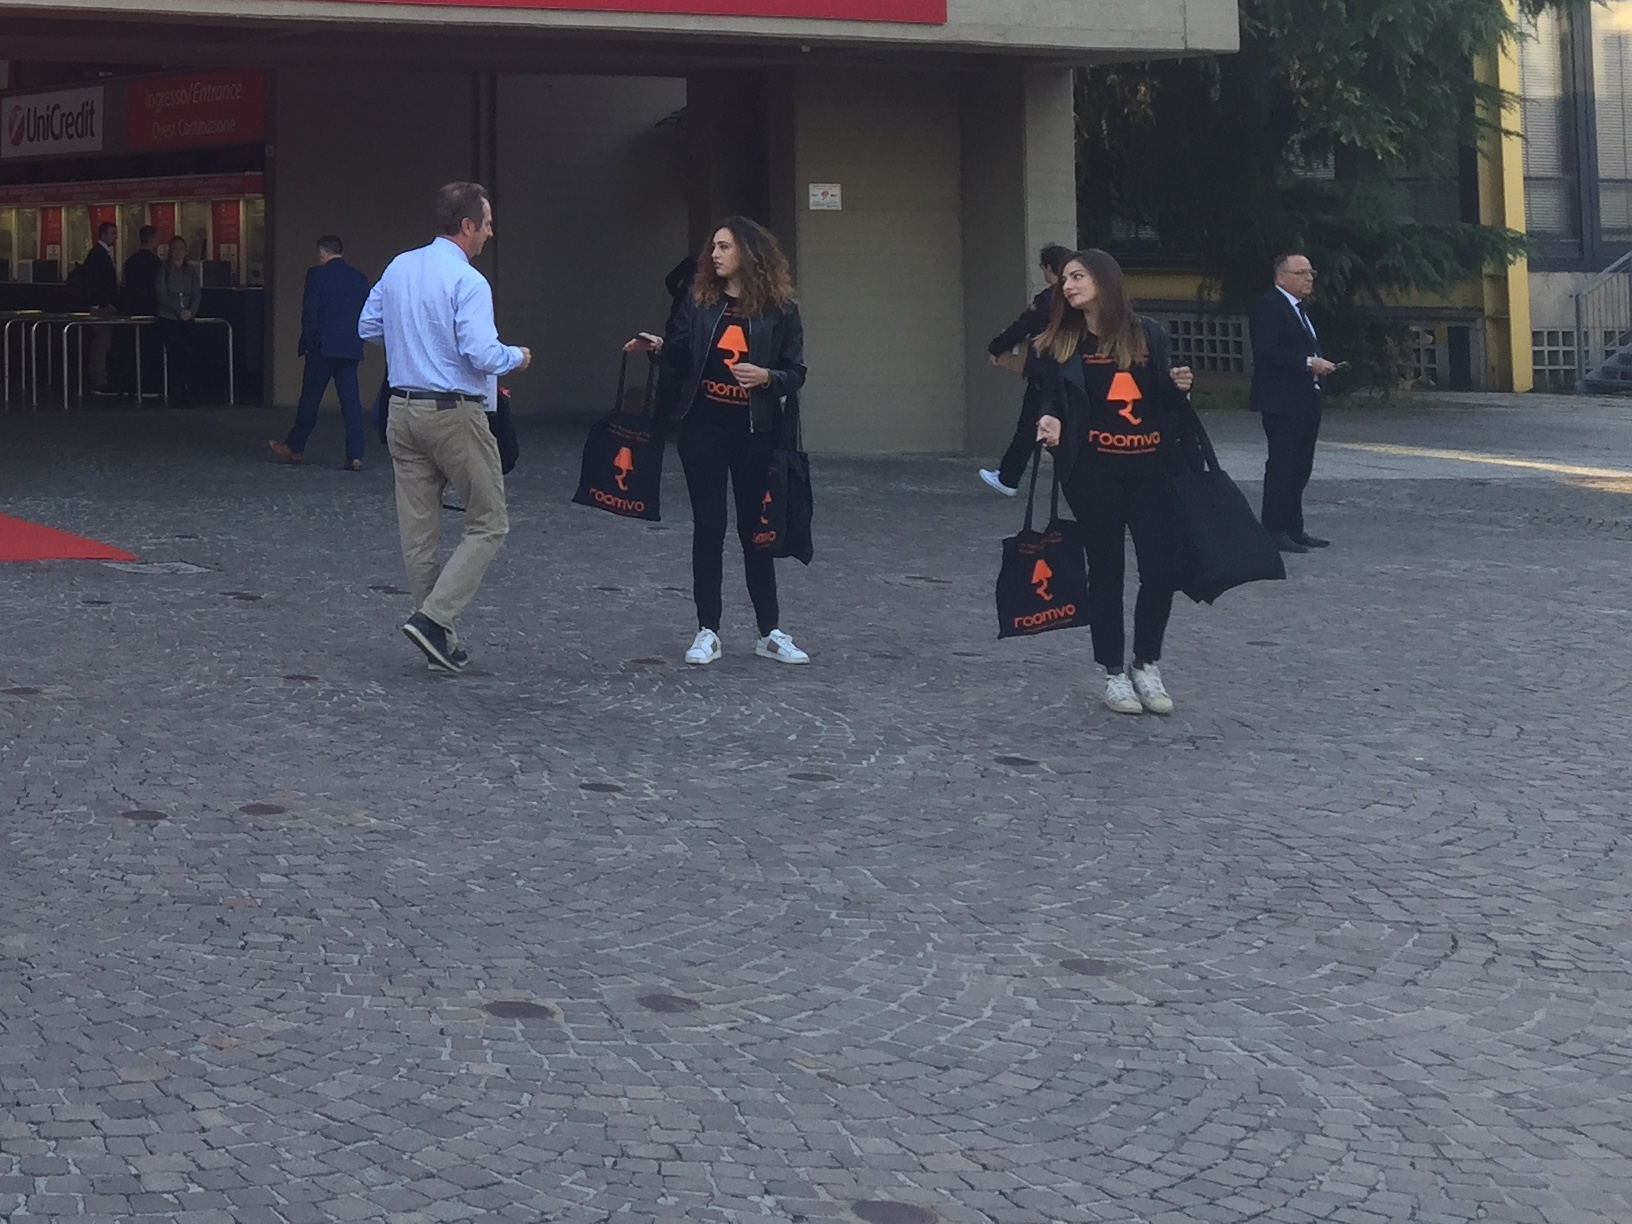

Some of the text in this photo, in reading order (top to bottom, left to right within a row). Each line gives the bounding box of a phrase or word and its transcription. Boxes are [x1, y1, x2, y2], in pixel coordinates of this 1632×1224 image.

[145, 82, 243, 113] Ingresso/Entrance
[26, 100, 95, 143] UniCredit
[701, 379, 749, 399] roomv
[1088, 429, 1161, 447] roomvo
[589, 487, 645, 513] roomvo
[1013, 603, 1077, 629] roomvo
